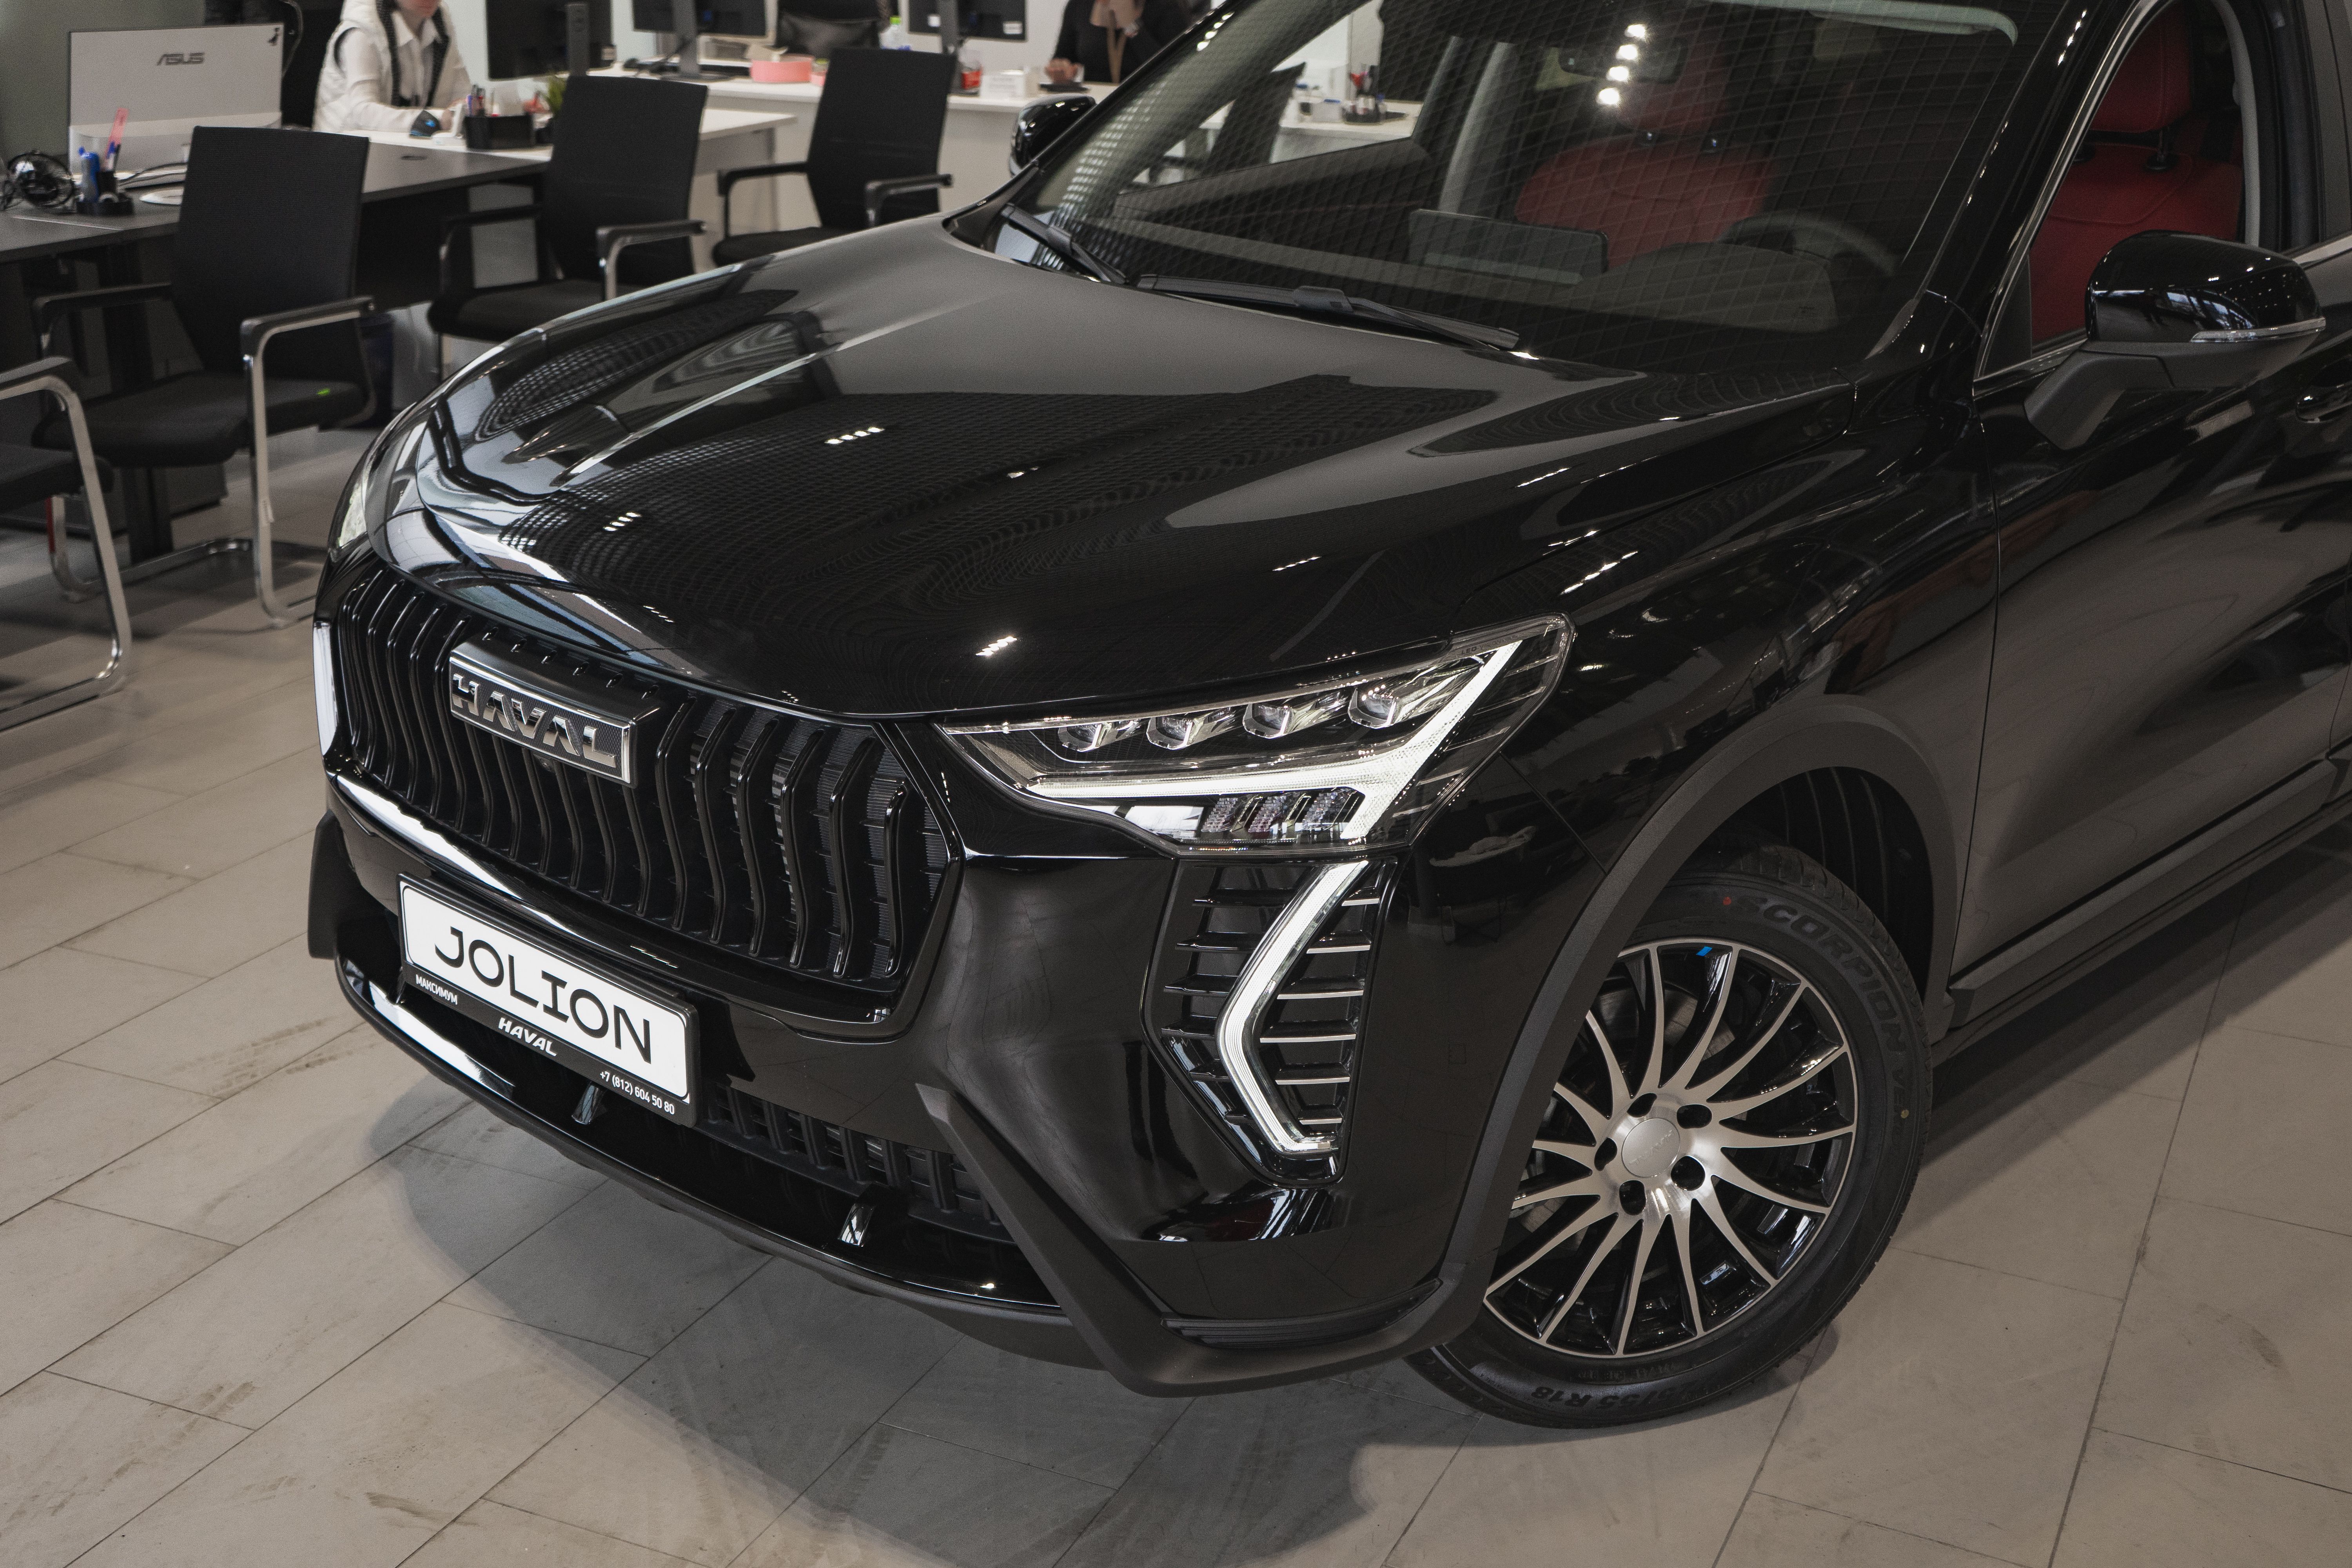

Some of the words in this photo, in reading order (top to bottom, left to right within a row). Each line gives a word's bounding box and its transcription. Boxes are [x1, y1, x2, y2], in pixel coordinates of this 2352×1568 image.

[156, 52, 205, 66] ASUS
[1461, 646, 1477, 655] LED
[452, 673, 617, 768] HAVAL
[416, 974, 458, 1005] МАКСИМУМ
[1729, 894, 1906, 1053] SCORPION
[435, 926, 652, 1065] JOLION
[498, 1017, 557, 1057] HAVAL
[600, 1071, 610, 1082] +7
[612, 1074, 633, 1095] (812)
[635, 1086, 650, 1103] 604
[652, 1094, 662, 1109] 50
[664, 1101, 675, 1115] 80
[1530, 1386, 1592, 1408] R18
